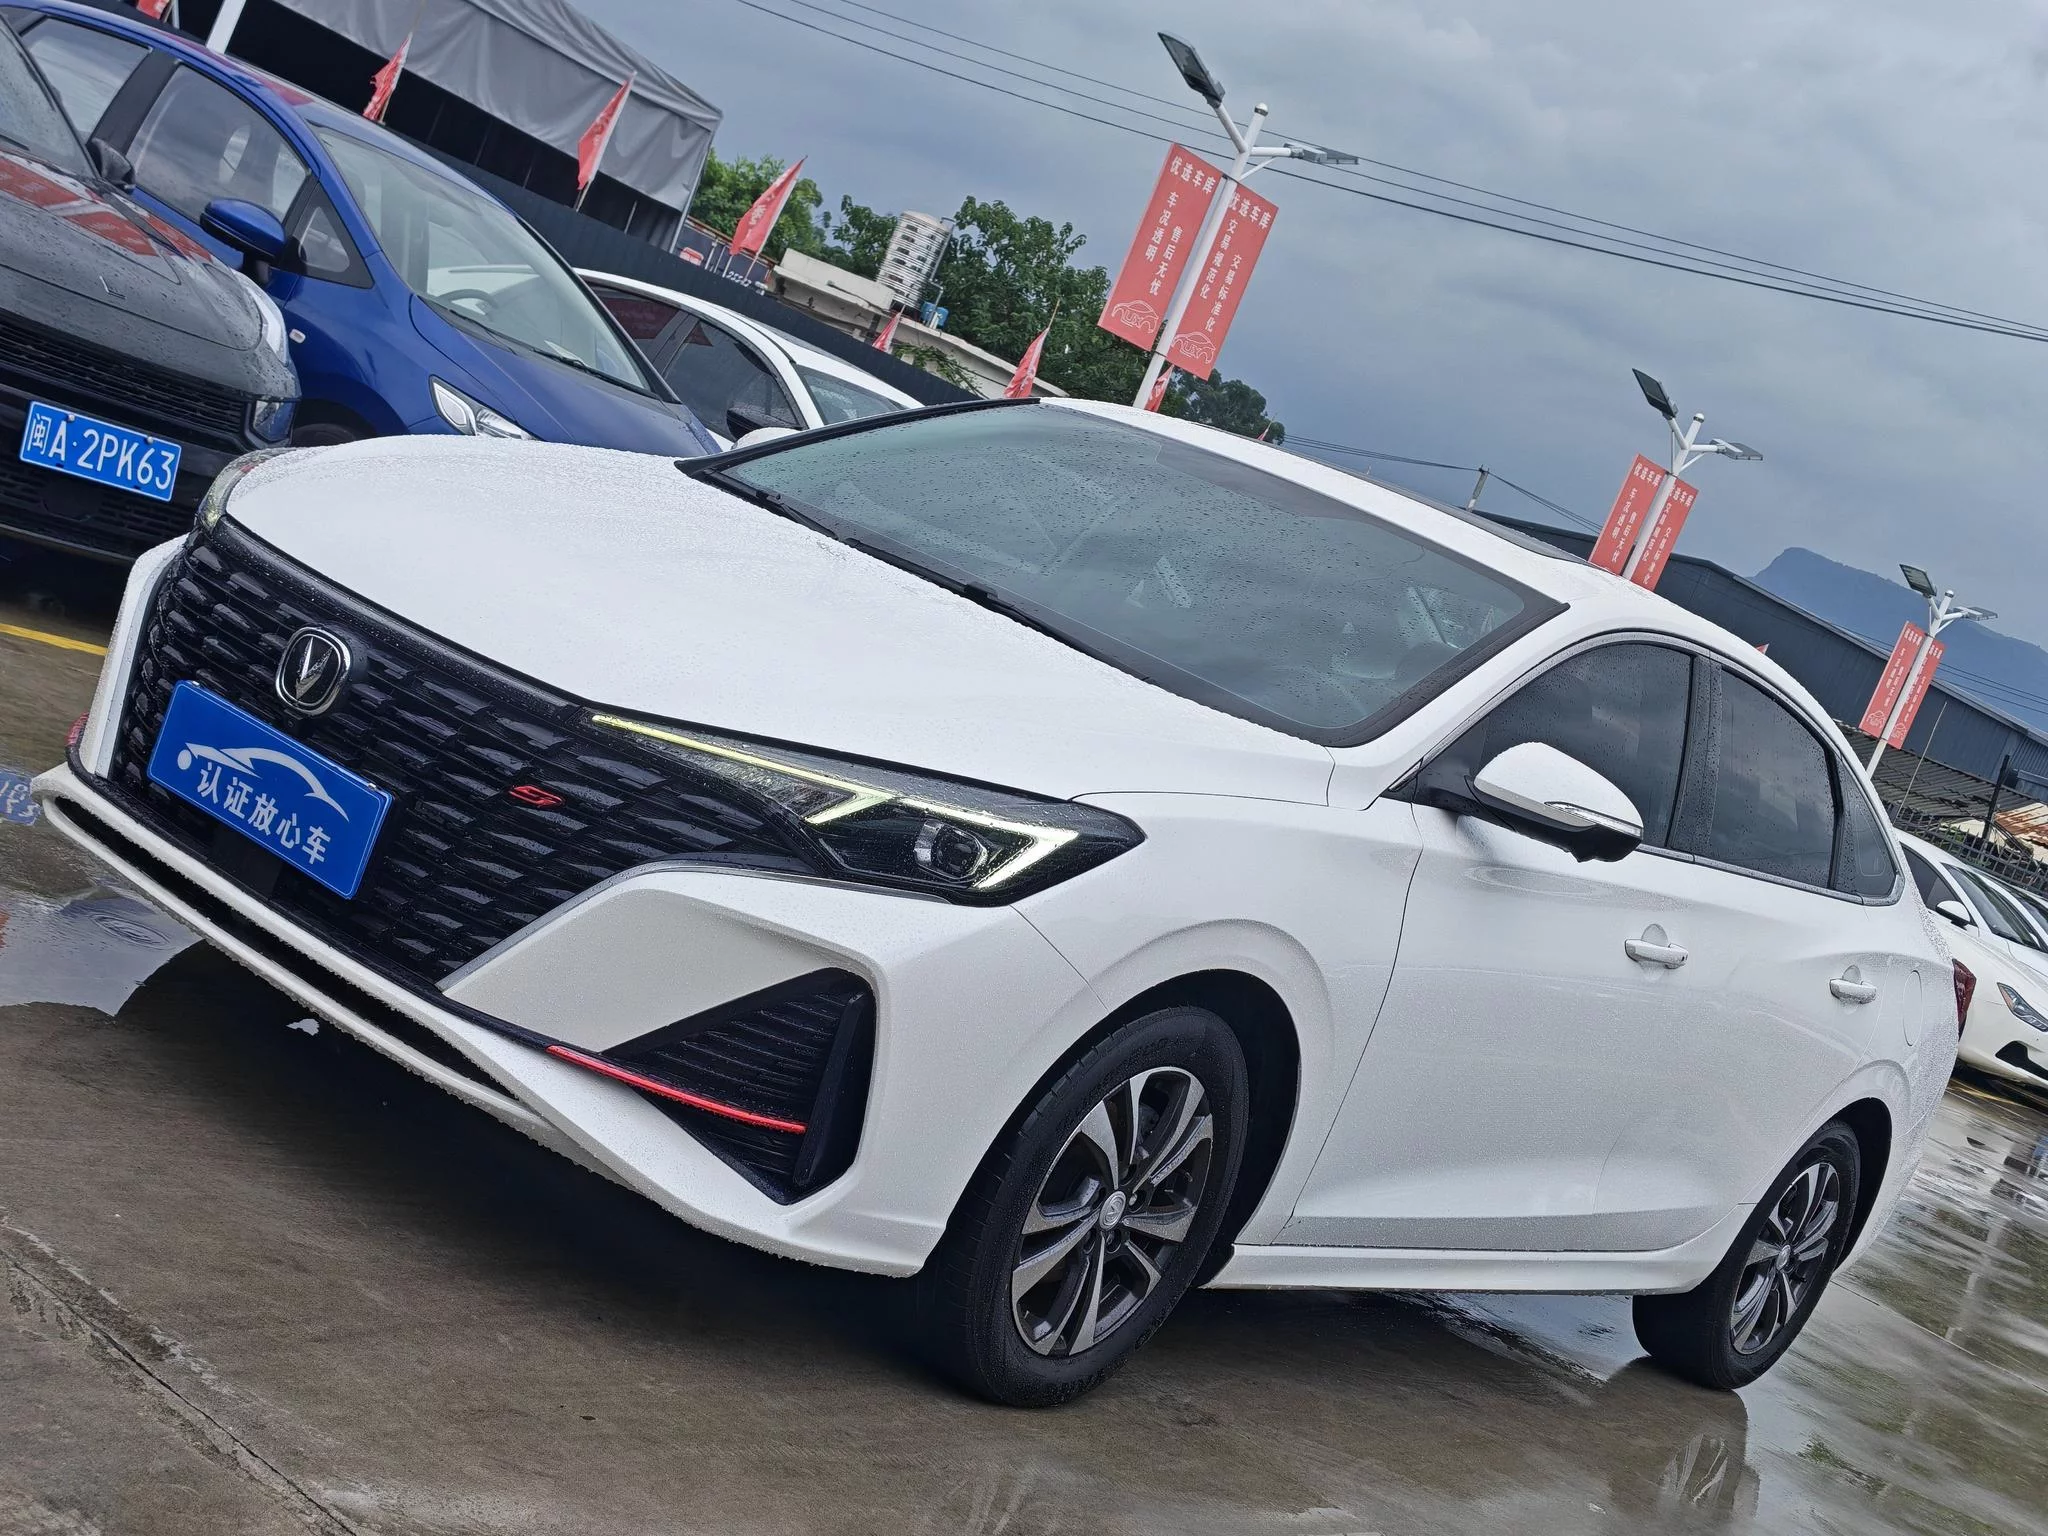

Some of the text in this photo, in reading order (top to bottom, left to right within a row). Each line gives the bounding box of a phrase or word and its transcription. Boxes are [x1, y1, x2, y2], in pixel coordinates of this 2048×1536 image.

[1170, 156, 1216, 195] 优选车库
[1145, 192, 1179, 262] 车况透明
[1150, 226, 1184, 296] 售后无忧
[1200, 219, 1238, 299] 交易规范化
[1205, 254, 1242, 333] 交易标准化
[27, 413, 175, 490] 闽A·2PK63
[197, 762, 331, 864] 认证放心车
